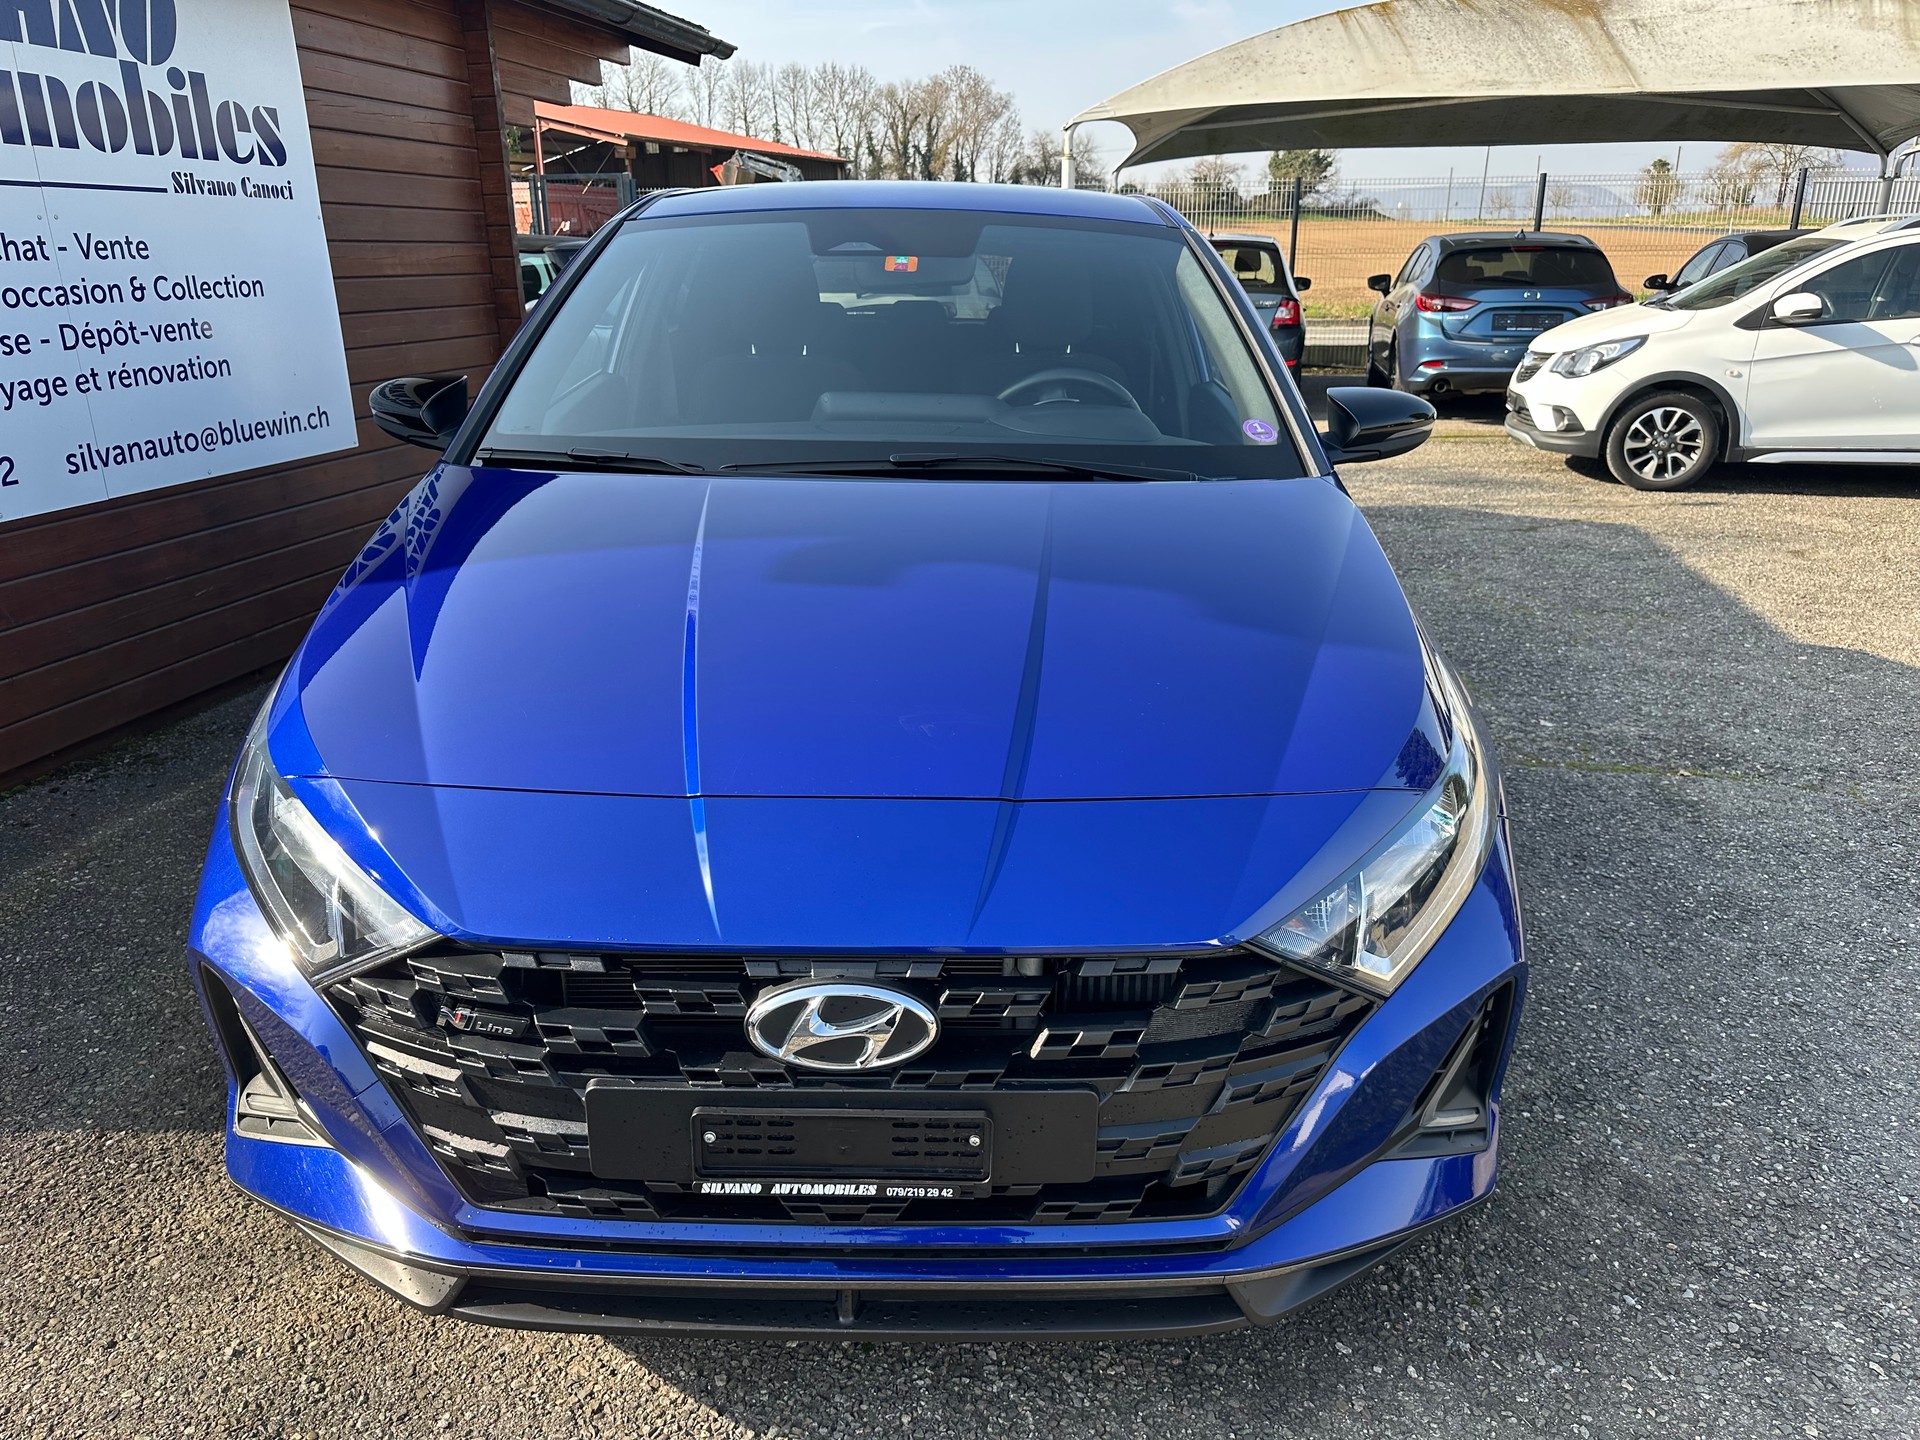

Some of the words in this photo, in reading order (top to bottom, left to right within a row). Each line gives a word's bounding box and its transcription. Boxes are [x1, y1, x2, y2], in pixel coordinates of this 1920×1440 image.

[171, 171, 237, 197] Silvano
[241, 176, 294, 200] Canoci
[0, 232, 50, 262] hat
[73, 232, 150, 260] Vente
[1, 277, 124, 309] occasion
[129, 276, 147, 303] &
[153, 274, 265, 301] Collection
[58, 317, 213, 354] Dépôt-vente
[0, 375, 69, 411] yage
[75, 367, 102, 394] et
[107, 355, 232, 390] rénovation
[65, 405, 331, 475] silvanauto@bluewin.ch
[475, 1021, 514, 1035] Line
[701, 1182, 762, 1194] SILVANO
[770, 1183, 877, 1195] AUTOMOBILES
[886, 1187, 925, 1197] 079/219
[926, 1187, 939, 1197] 29
[940, 1188, 953, 1198] 42
